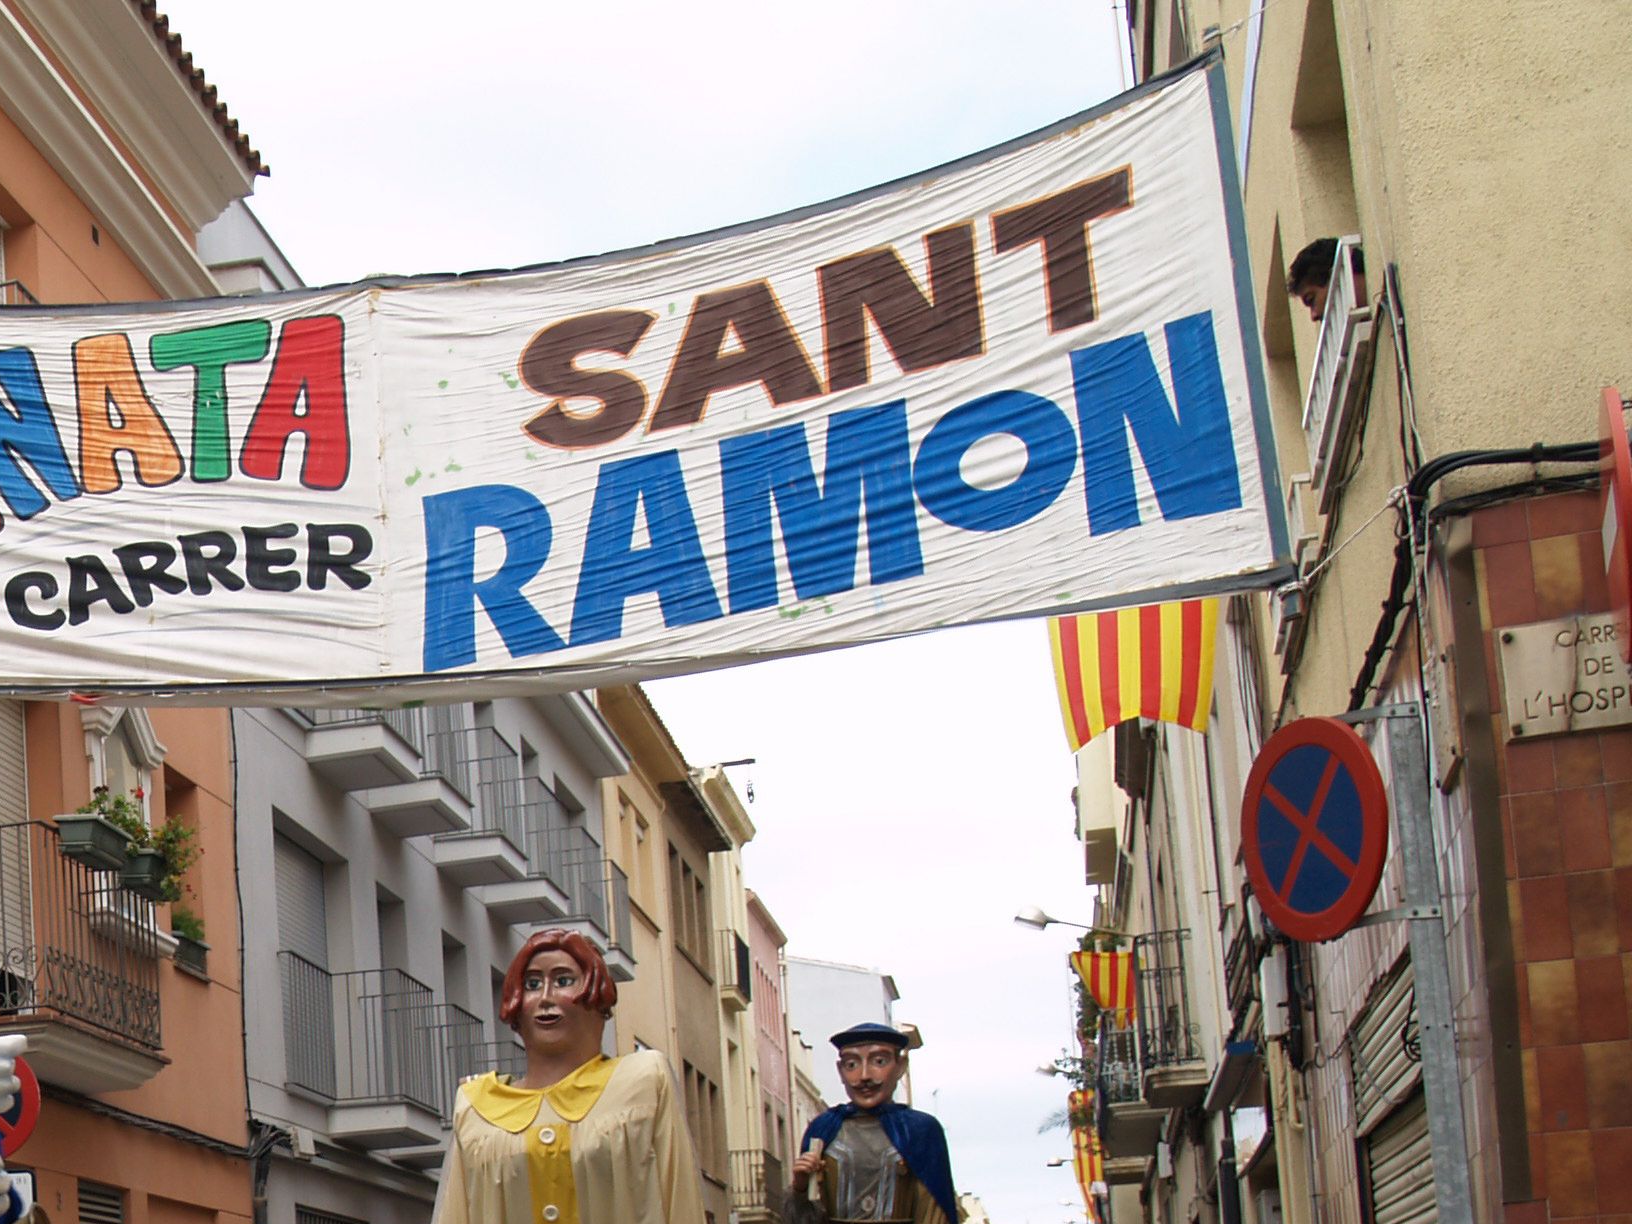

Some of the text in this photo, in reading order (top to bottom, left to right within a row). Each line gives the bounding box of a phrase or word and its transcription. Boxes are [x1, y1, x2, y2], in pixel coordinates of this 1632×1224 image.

[518, 163, 1133, 449] SANT
[5, 522, 374, 631] CARRER
[422, 309, 1242, 672] RAMON
[1584, 656, 1614, 676] DE
